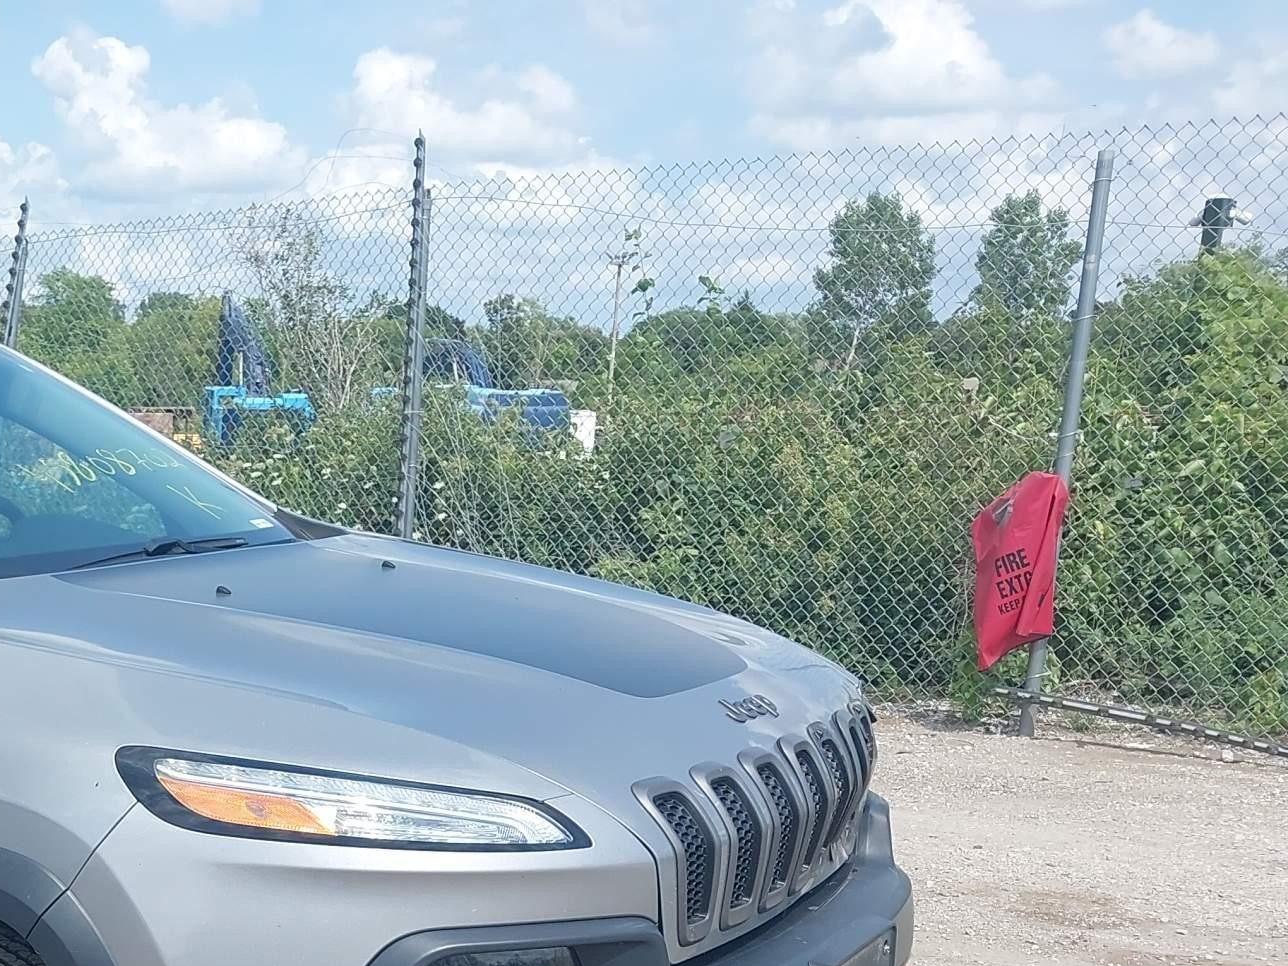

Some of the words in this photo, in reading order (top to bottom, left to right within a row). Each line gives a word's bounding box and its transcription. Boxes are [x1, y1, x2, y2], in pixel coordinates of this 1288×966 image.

[994, 548, 1031, 578] FIRE
[997, 598, 1021, 616] KEEP
[717, 693, 780, 724] Jeep
